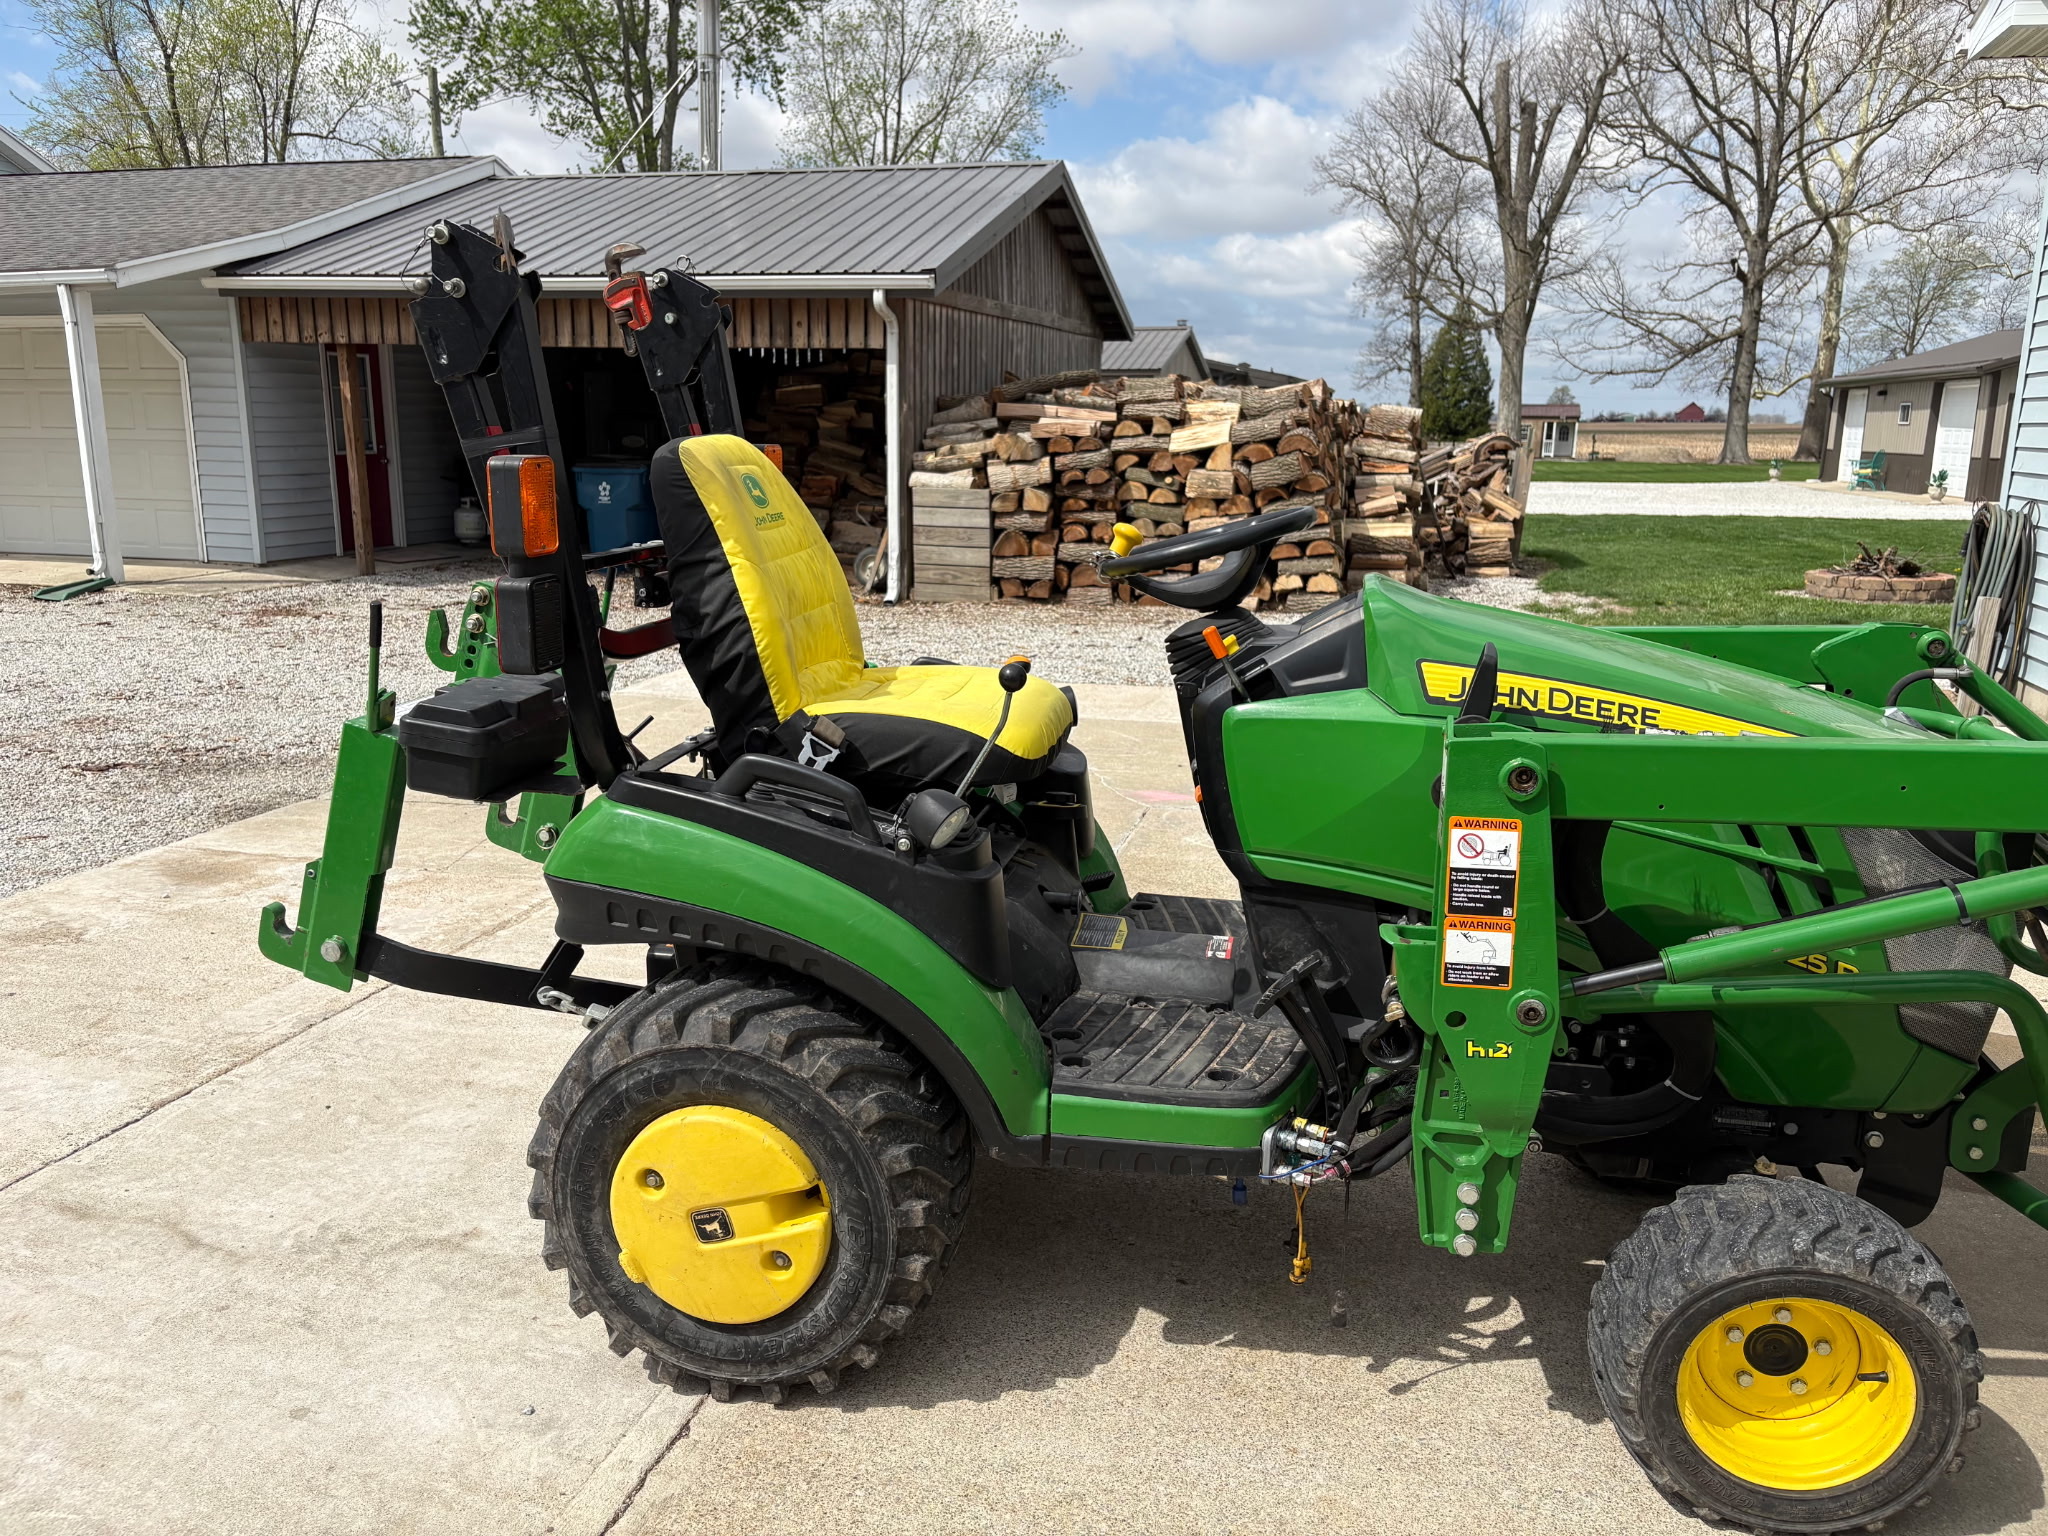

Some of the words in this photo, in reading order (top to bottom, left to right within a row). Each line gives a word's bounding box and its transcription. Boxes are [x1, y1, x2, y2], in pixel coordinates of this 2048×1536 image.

[754, 515, 768, 526] JOHN
[766, 512, 785, 523] DEERE
[1448, 676, 1539, 709] JHN
[1548, 687, 1660, 728] DEERE
[1464, 819, 1518, 830] WARNING
[1459, 920, 1511, 931] WARNING
